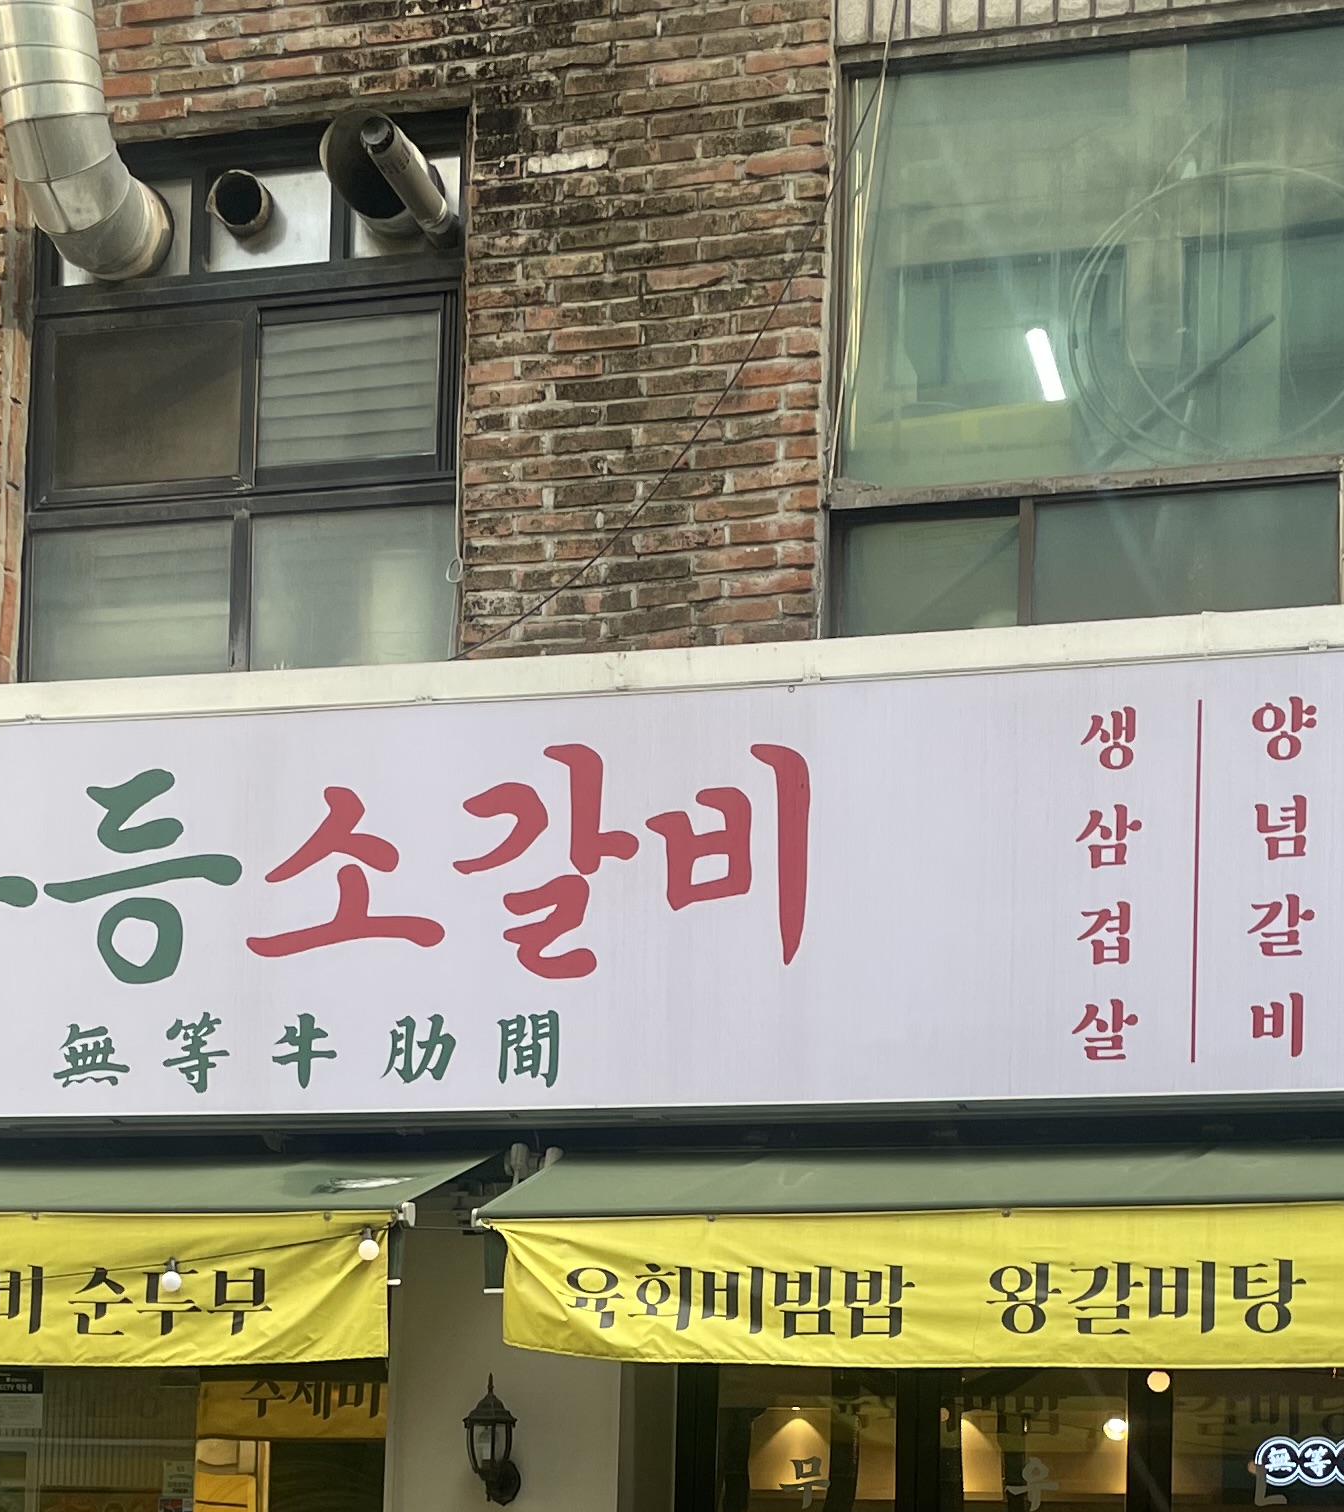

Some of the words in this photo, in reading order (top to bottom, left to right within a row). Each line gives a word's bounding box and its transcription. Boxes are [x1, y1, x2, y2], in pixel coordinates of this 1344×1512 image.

[1071, 705, 1143, 1061] 생삼겹살
[1247, 696, 1318, 1057] 양념갈비
[68, 1267, 272, 1335] 순두부
[560, 1262, 916, 1339] 육회비빔밥
[986, 1258, 1307, 1336] 왕갈비탕
